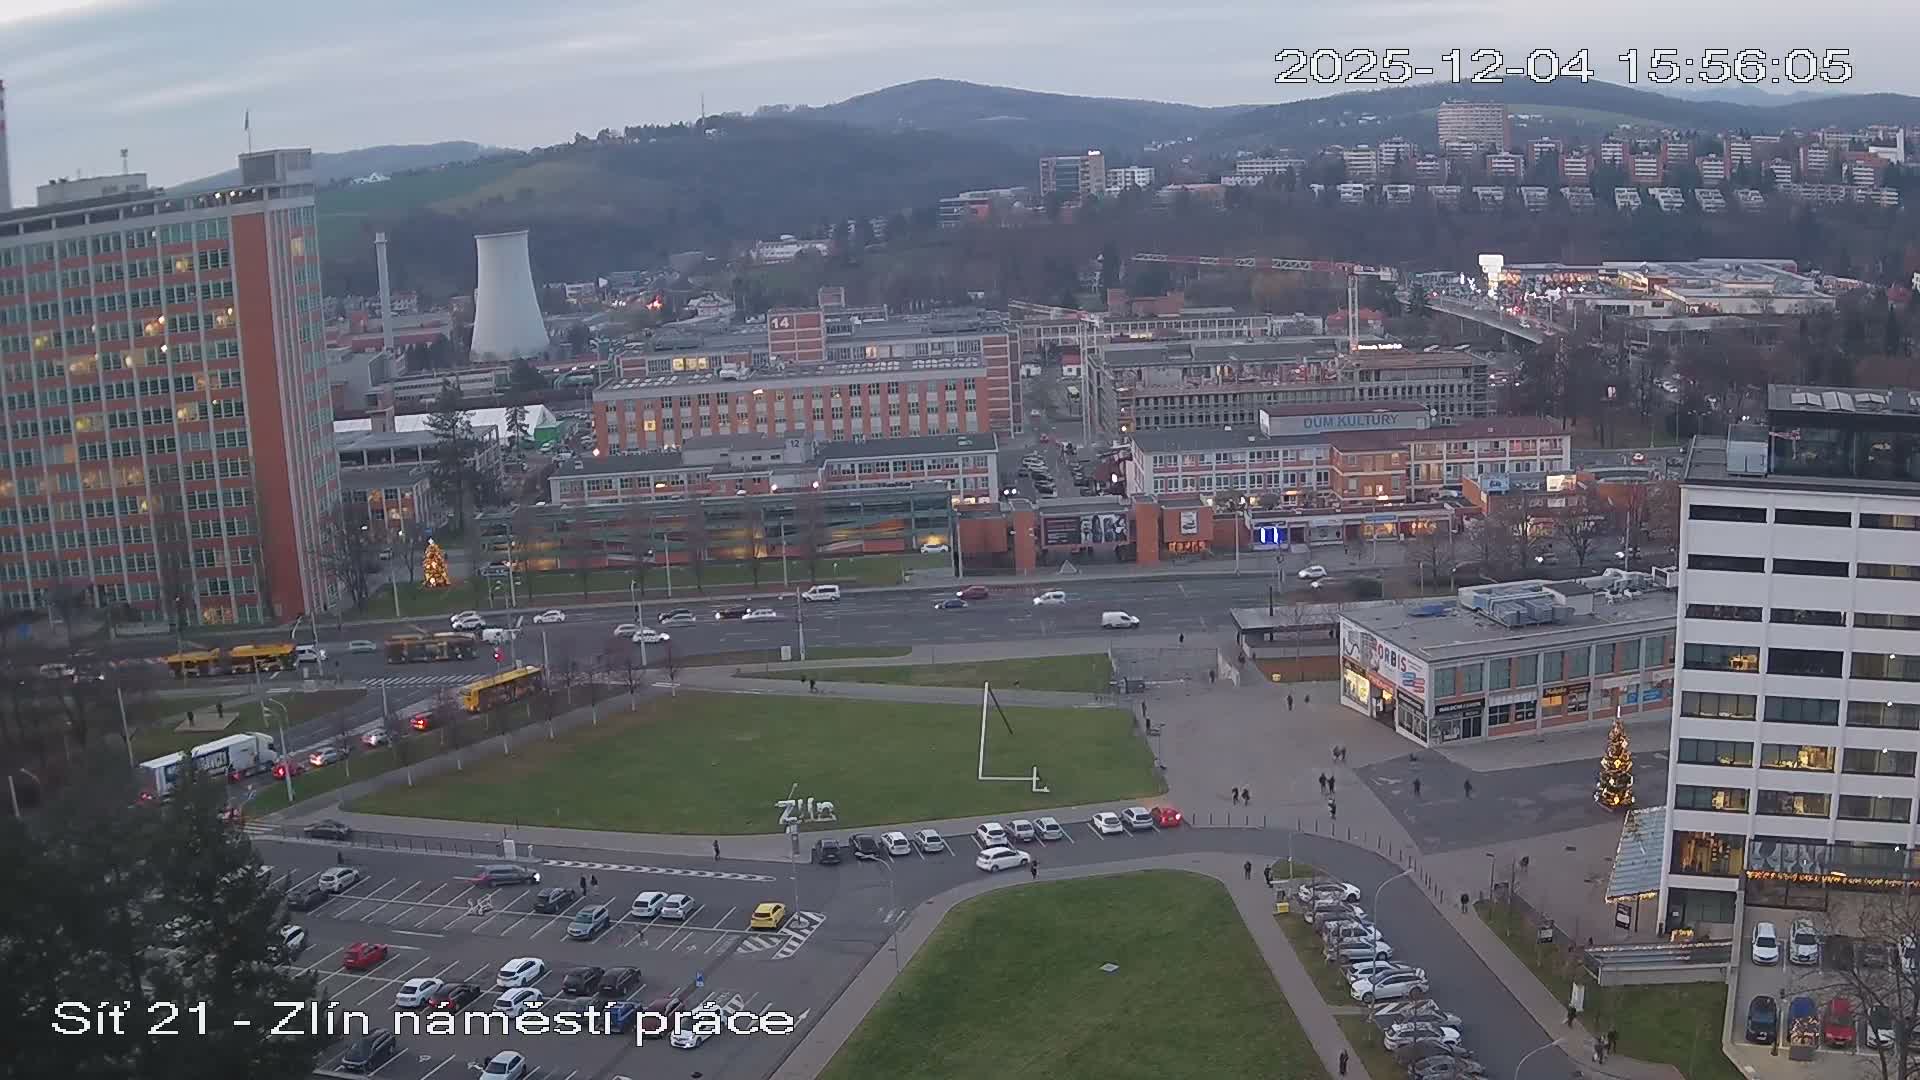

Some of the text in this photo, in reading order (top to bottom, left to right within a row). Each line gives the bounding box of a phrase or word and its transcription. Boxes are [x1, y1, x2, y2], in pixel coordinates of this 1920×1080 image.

[771, 317, 790, 329] 14
[1337, 414, 1399, 427] KULTURY
[790, 439, 800, 448] 12
[1377, 643, 1407, 672] ORBIS
